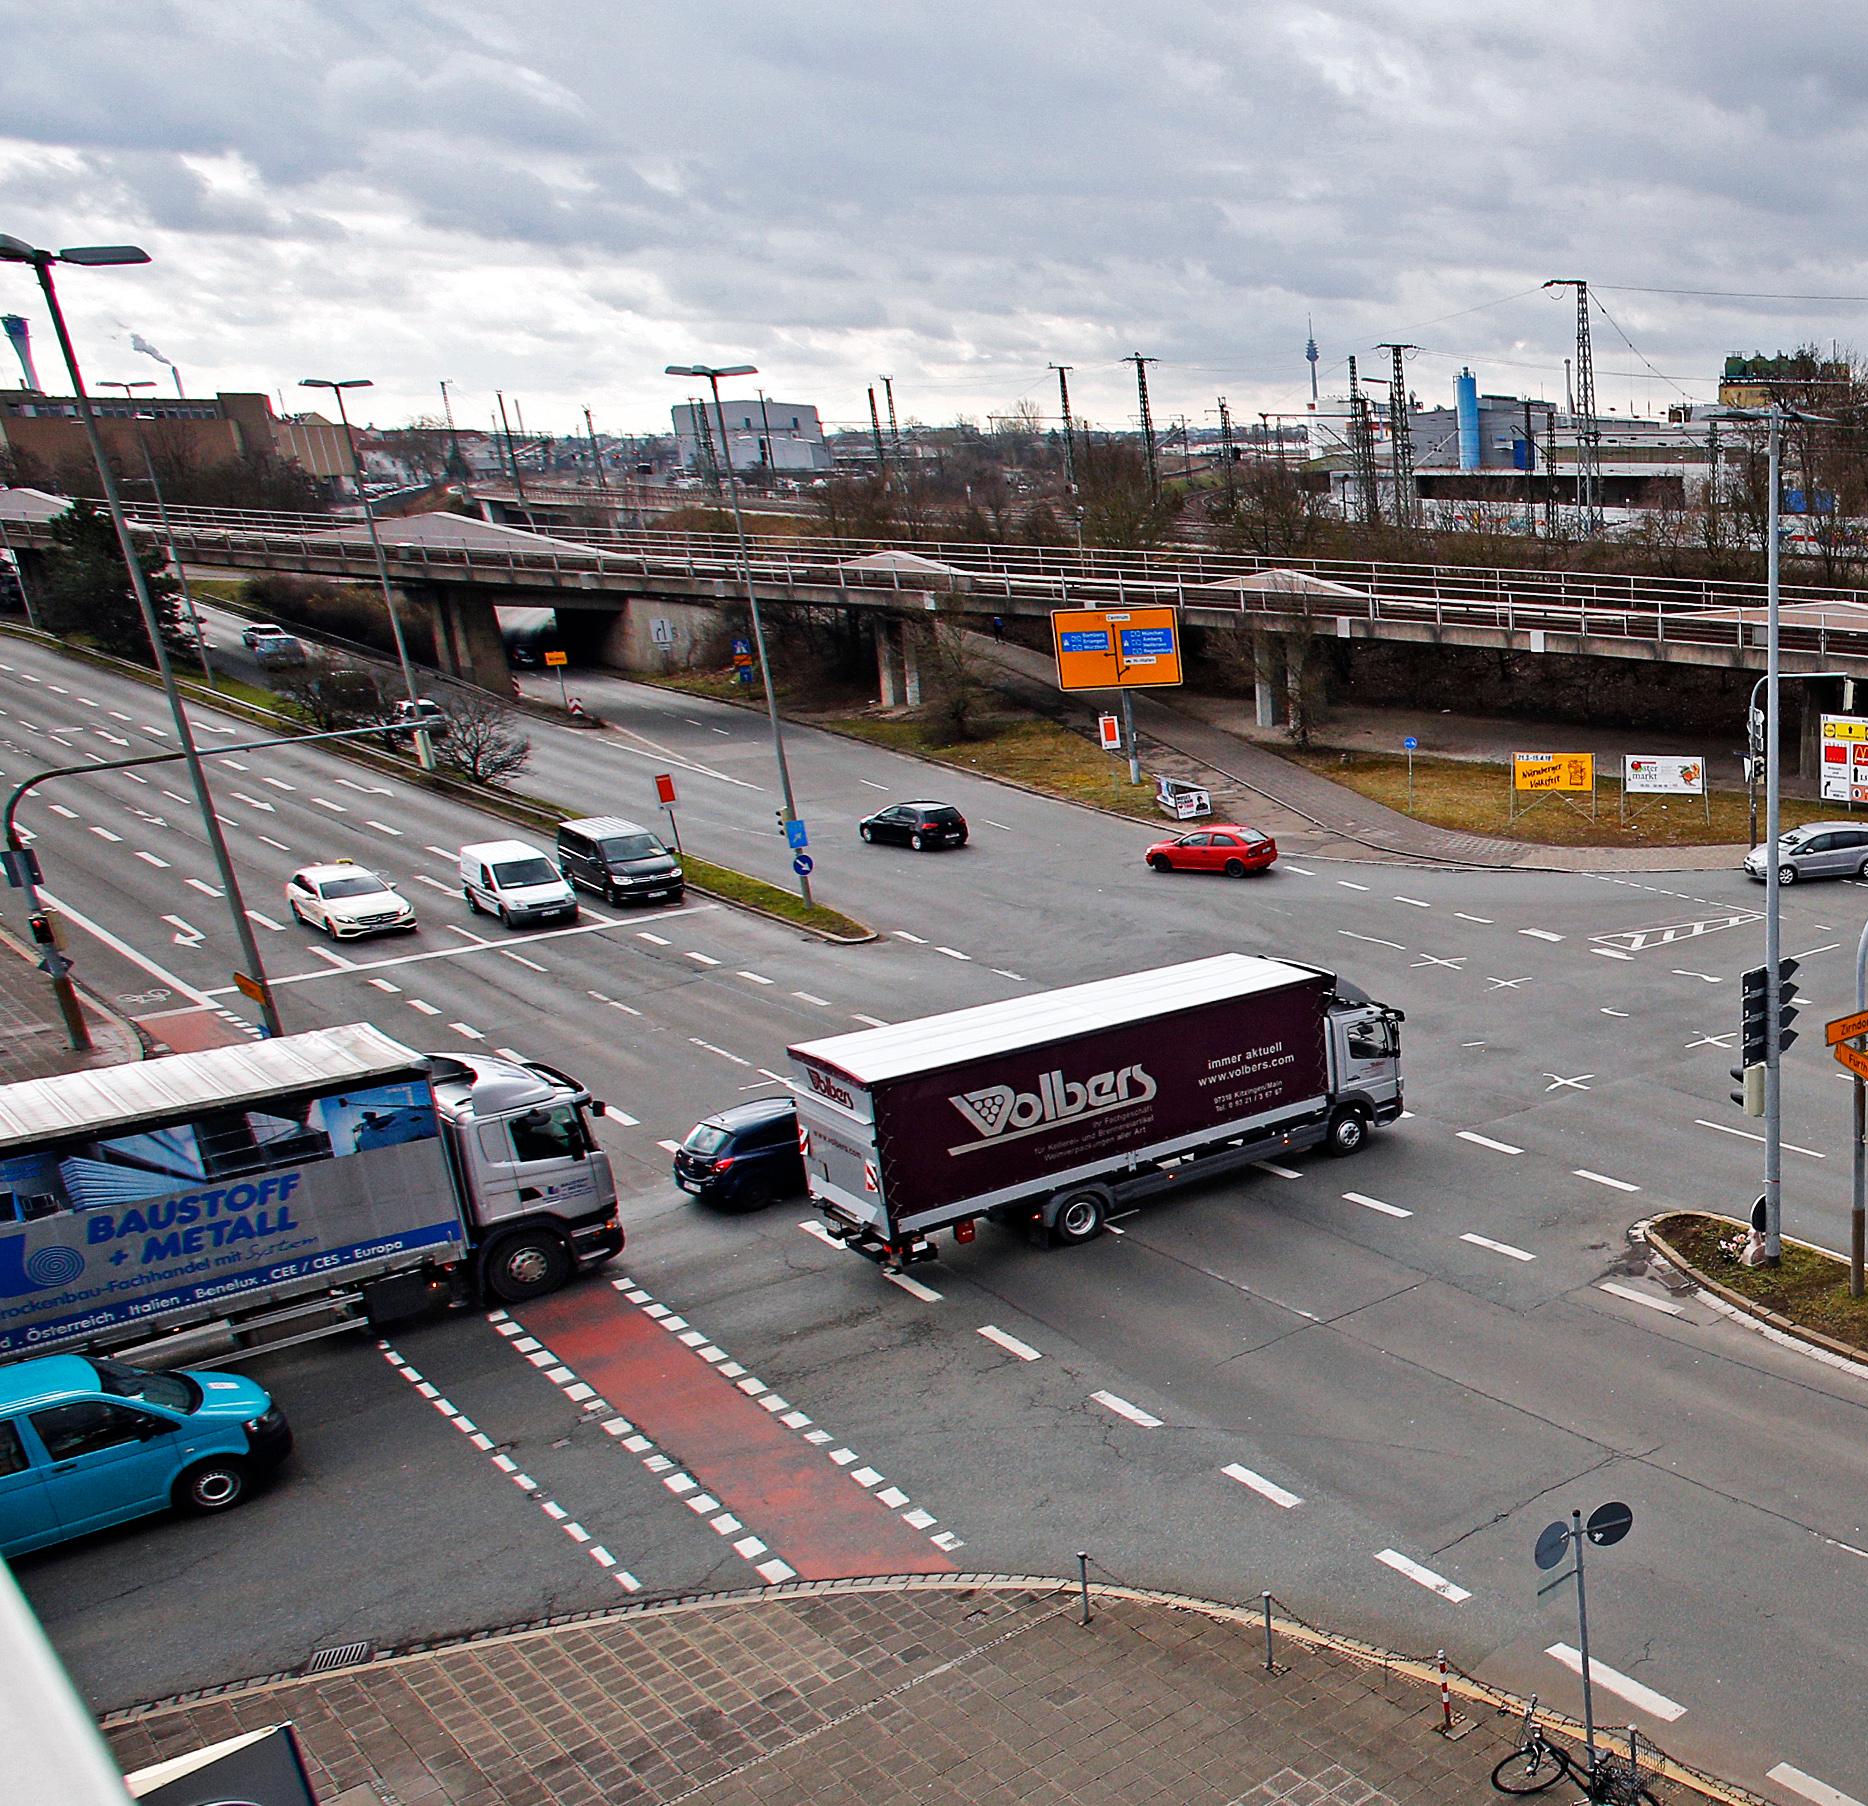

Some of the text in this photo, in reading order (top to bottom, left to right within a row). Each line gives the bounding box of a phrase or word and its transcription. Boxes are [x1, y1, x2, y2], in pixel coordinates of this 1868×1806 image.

[1198, 1054, 1295, 1087] www.volbers.com
[1207, 1041, 1283, 1070] immer aktuell
[1848, 1054, 1868, 1073] Fürth
[949, 1061, 1158, 1137] Volbers
[1134, 1126, 1146, 1135] Art
[87, 1173, 300, 1245] BAUSTOFF
[141, 1206, 299, 1265] METALL
[214, 1250, 242, 1268] mit
[26, 1310, 116, 1342] Österreich
[129, 1294, 181, 1314] Italien
[195, 1275, 259, 1298] Benelux
[271, 1264, 299, 1280] CEE
[313, 1254, 341, 1269] CES
[354, 1239, 404, 1259] Europa
